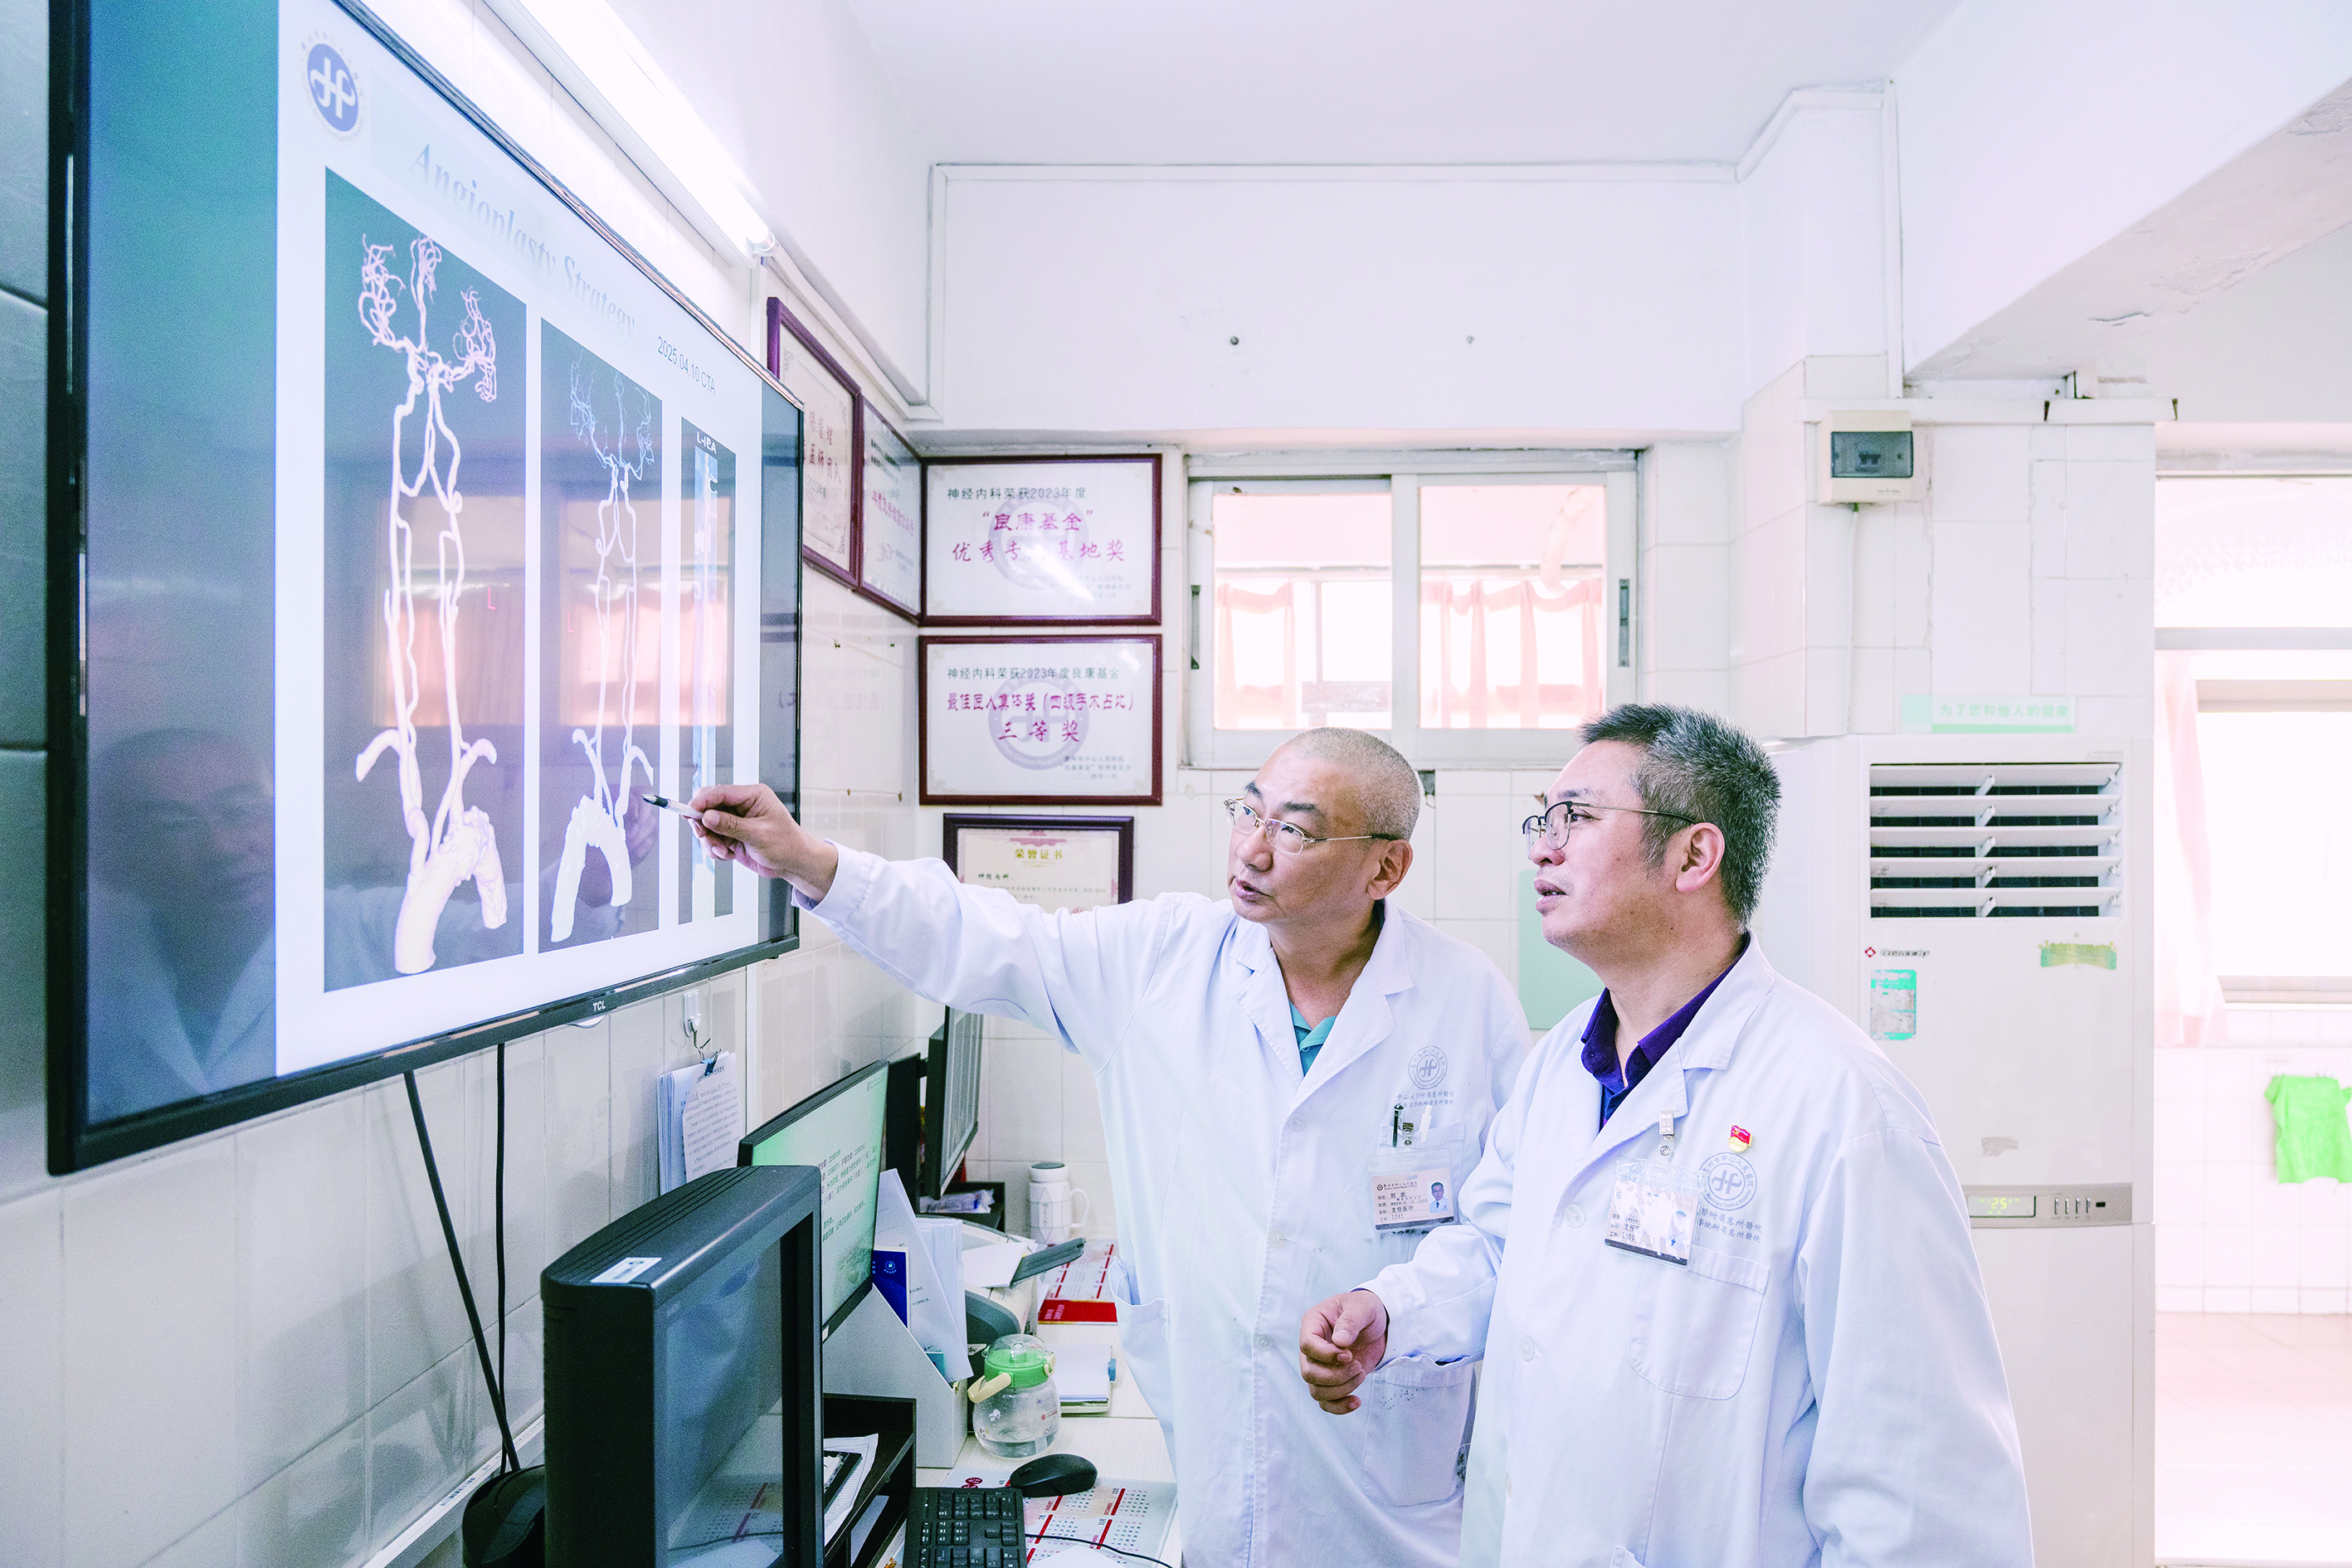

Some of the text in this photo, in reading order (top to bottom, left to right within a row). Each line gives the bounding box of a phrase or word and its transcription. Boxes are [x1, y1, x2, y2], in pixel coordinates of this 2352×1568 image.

[410, 144, 635, 338] Angioplasty Strategy
[658, 336, 716, 396] 2025.04.10 CTA
[947, 487, 1087, 499] 神经内科荣获2023年度
[952, 539, 1124, 562] 优秀专基地奖
[947, 667, 1120, 679] 神经内科荣获2023年度良康基金
[1941, 704, 2068, 717] 为了您和他人的健康
[998, 719, 1079, 742] 三等奖
[1015, 849, 1063, 859] 荣誉证书
[593, 1000, 606, 1011] TCL
[1991, 1197, 2008, 1210] 25
